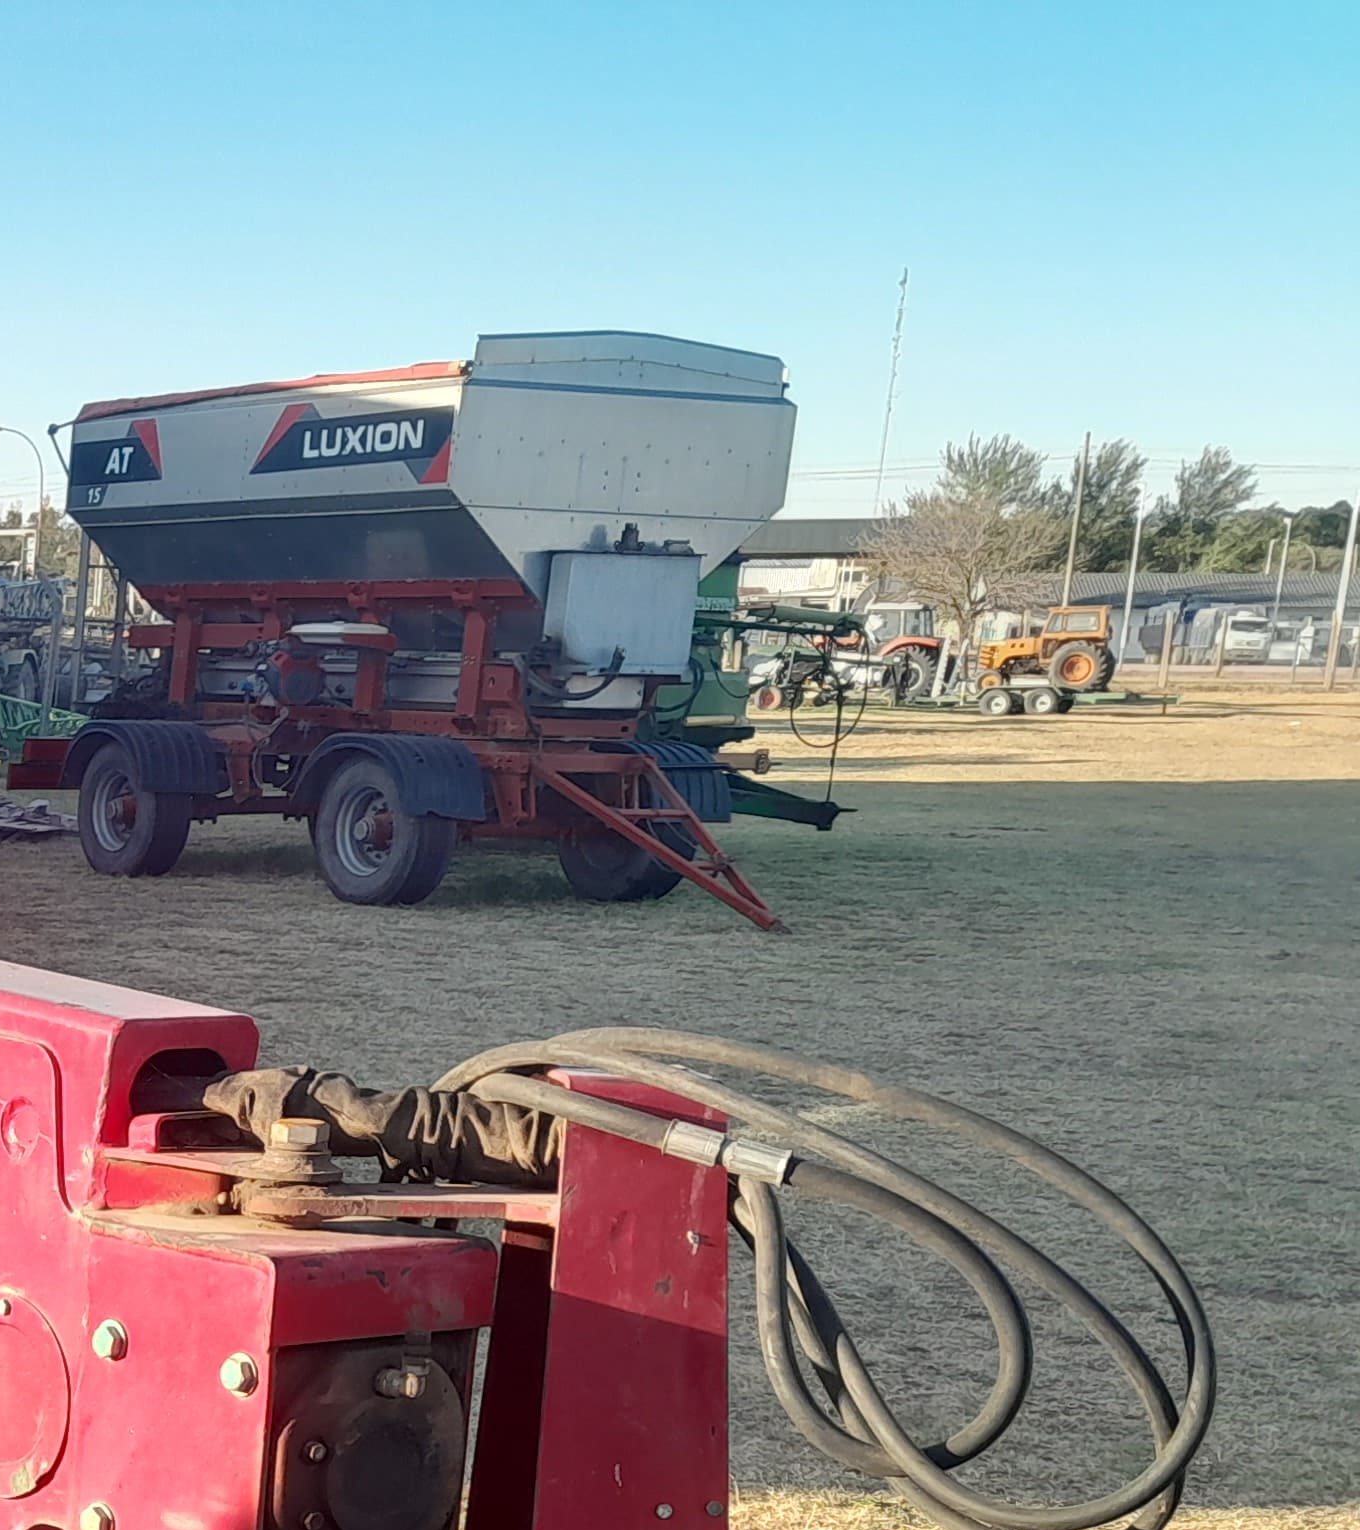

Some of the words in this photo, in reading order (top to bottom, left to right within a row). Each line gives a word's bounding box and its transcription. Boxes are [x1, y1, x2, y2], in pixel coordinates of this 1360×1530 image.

[302, 418, 425, 459] LUXION
[103, 446, 135, 475] AT
[87, 487, 102, 504] 15
